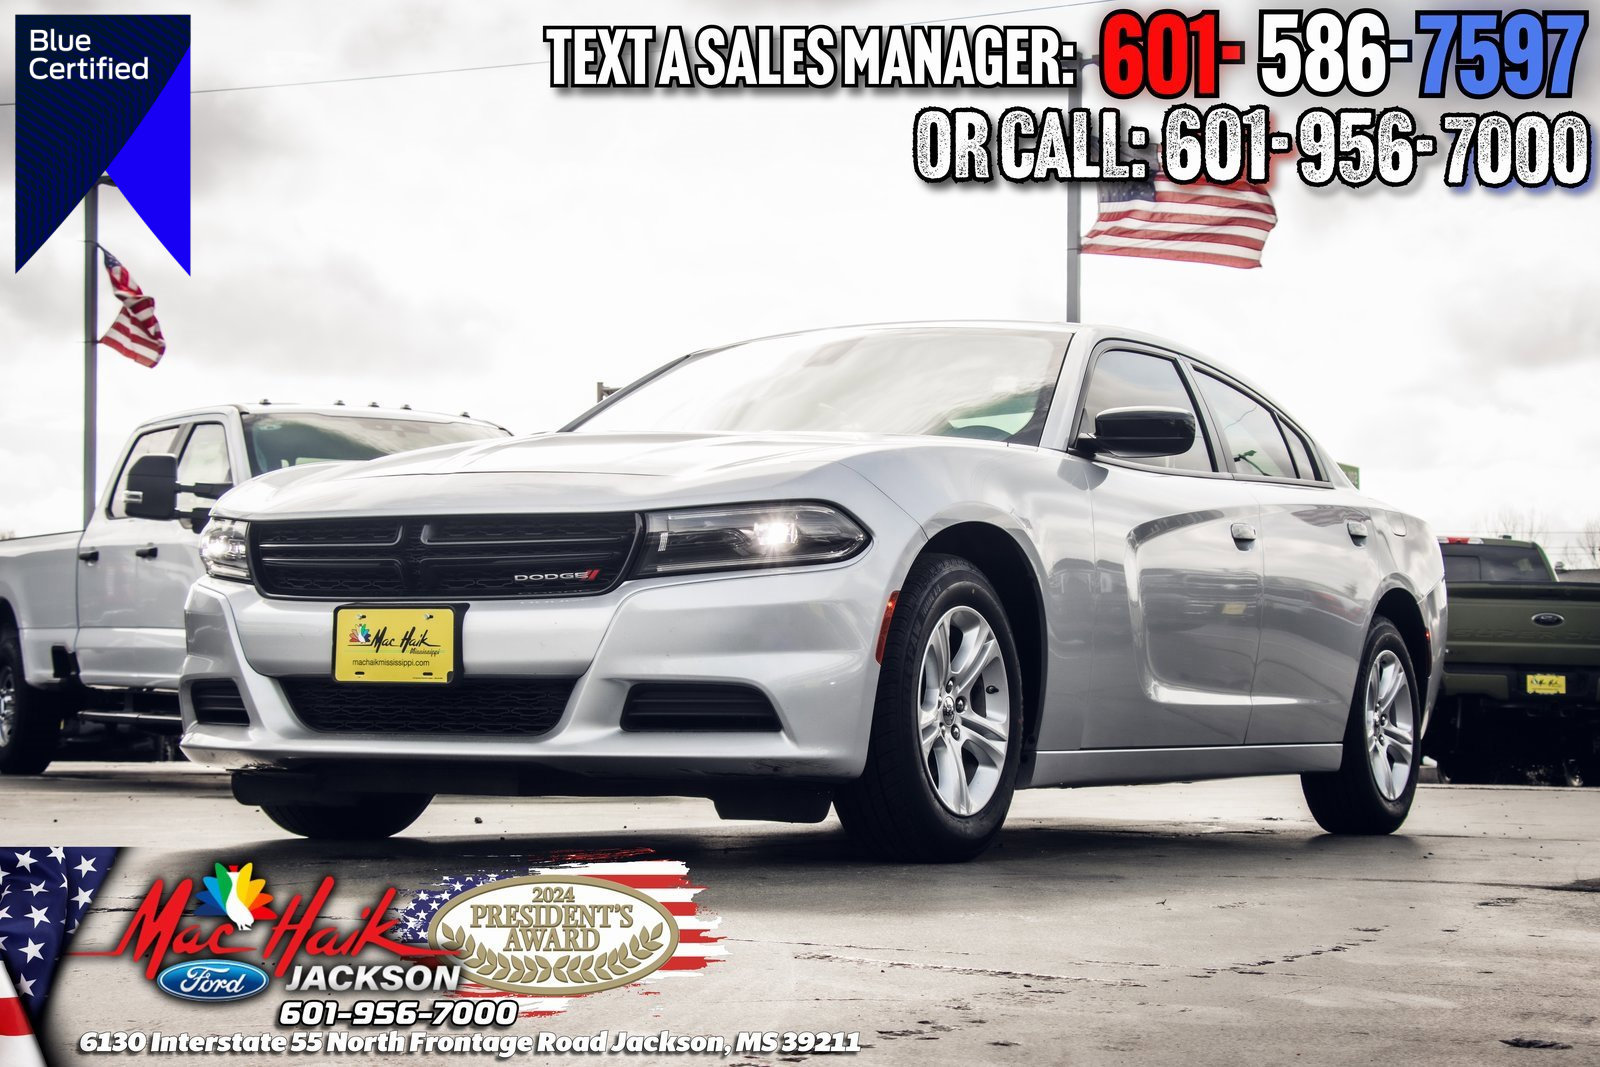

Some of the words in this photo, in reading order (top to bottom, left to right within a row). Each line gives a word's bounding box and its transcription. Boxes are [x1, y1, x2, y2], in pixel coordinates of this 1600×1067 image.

[514, 571, 590, 581] DODGE
[367, 626, 400, 653] Mac
[399, 626, 441, 653] Haik
[352, 658, 430, 668] machaikmississippi.com
